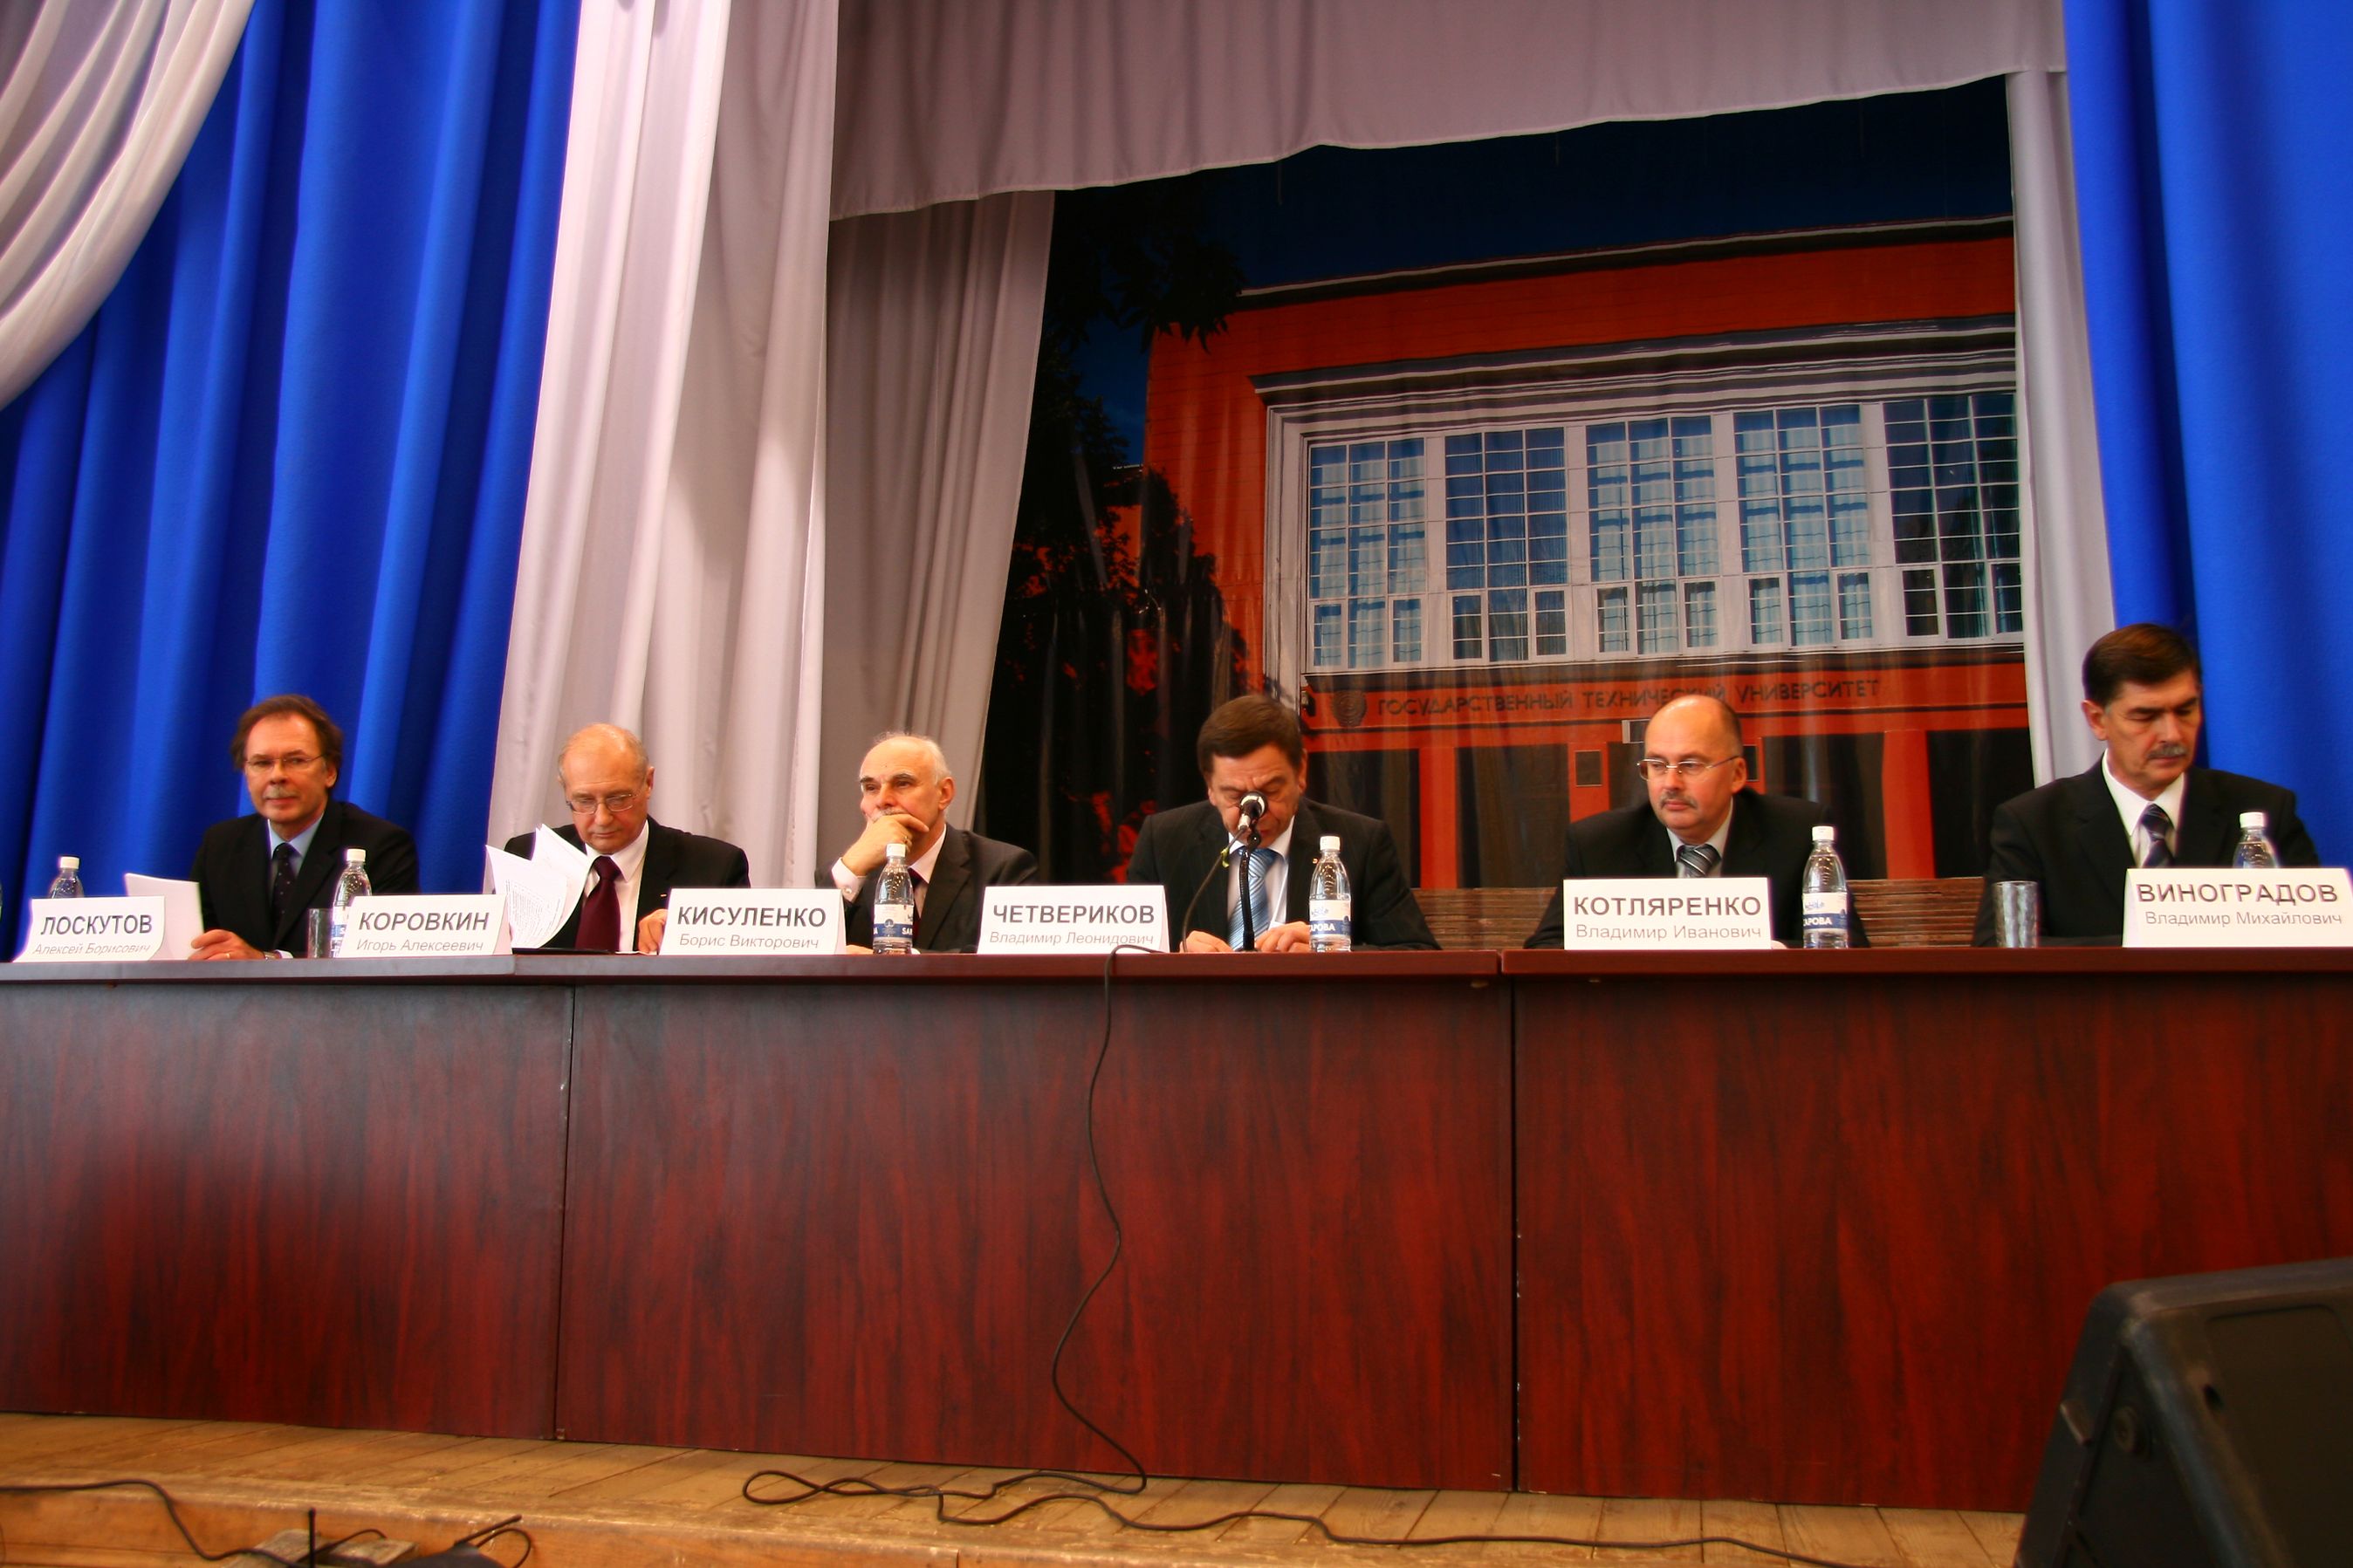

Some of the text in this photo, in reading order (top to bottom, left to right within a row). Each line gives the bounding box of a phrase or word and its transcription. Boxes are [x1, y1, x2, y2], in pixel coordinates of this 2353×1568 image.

[1378, 689, 1572, 716] ГОСУДАРСТВЕННЫЙ
[1735, 679, 1879, 703] УНИВЕРСИТЕТ
[2136, 883, 2338, 907] ВИНОГРАДОВ
[993, 904, 1155, 924] ЧЕТВЕРИКОВ
[1574, 896, 1761, 916] КОТЛЯРЕНКО
[40, 914, 153, 935] ЛОСКУТОВ
[358, 912, 490, 931] КОРОВКИН
[677, 906, 827, 928] КИСУЛЕНКО
[2145, 911, 2343, 928] Владимир Михайлович
[679, 934, 819, 950] Борис Викторович
[989, 932, 1154, 946] Владимир Леонидович
[1576, 924, 1761, 941] Владимир Иванович
[32, 942, 151, 955] Алексей Борисович
[356, 939, 484, 953] Игорь Алексеевич
